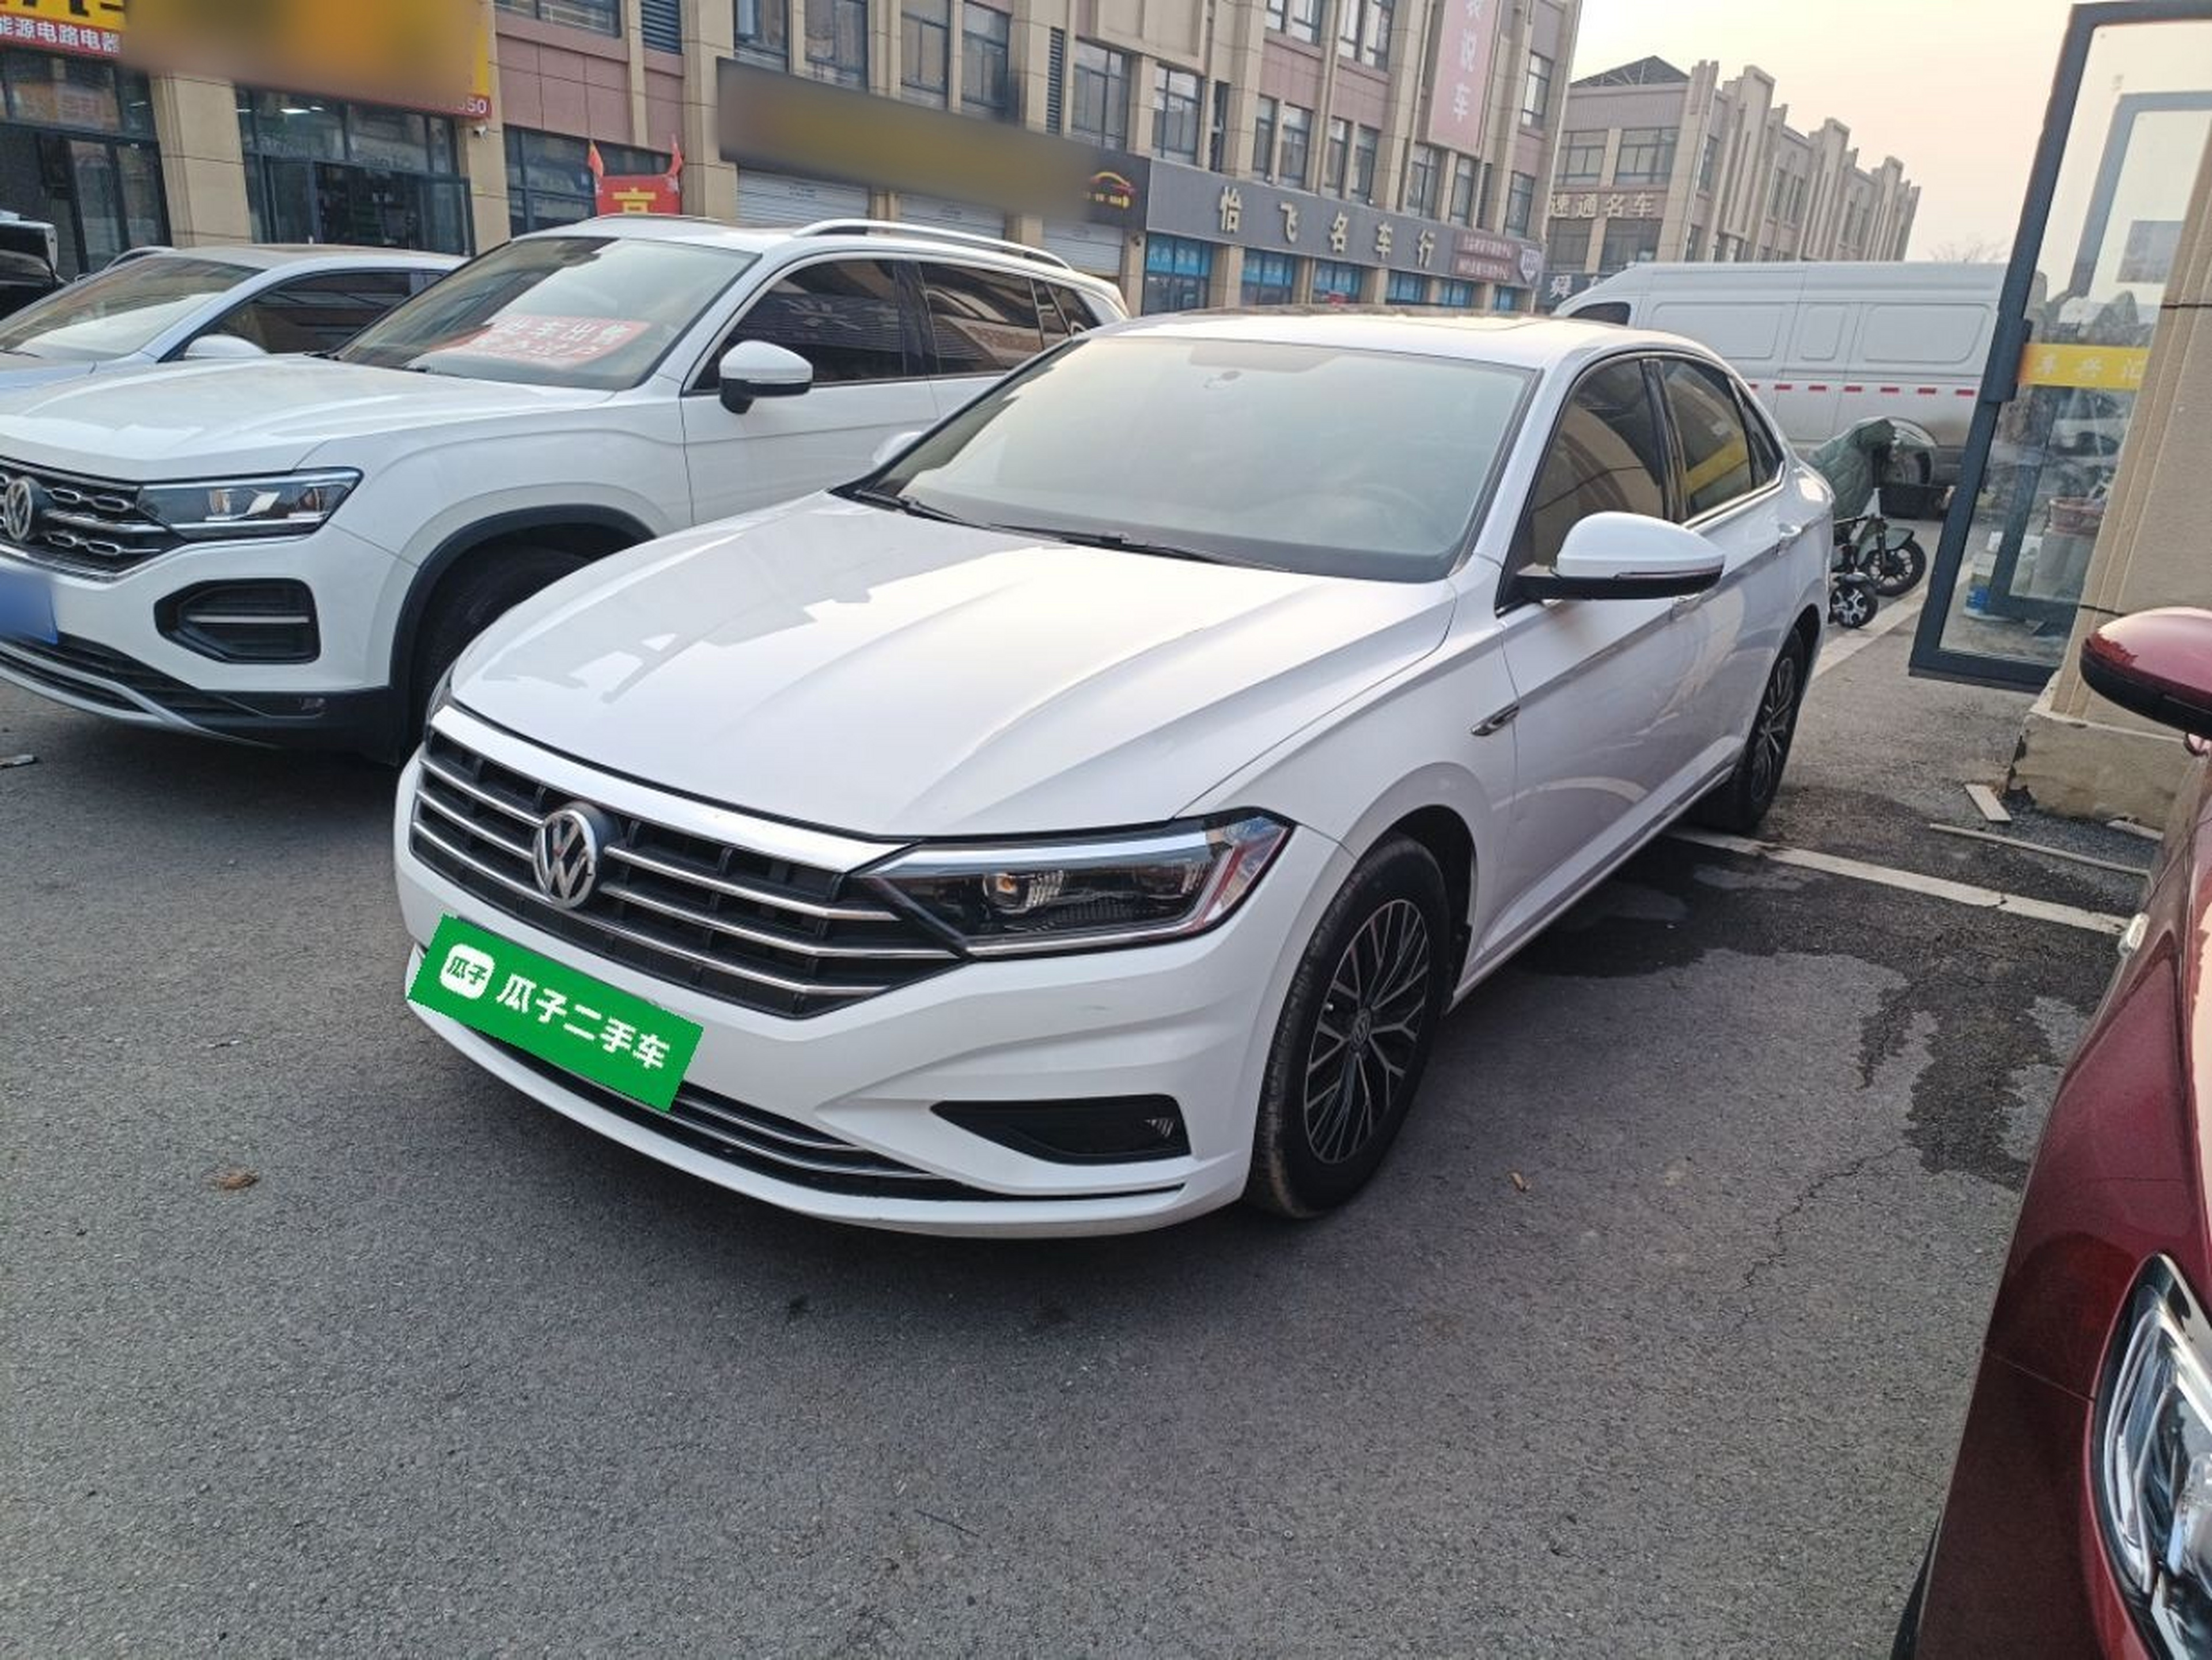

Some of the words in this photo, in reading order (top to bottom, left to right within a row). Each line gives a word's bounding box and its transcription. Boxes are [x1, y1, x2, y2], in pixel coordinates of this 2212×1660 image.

[1219, 186, 1436, 269] 怡飞名车行
